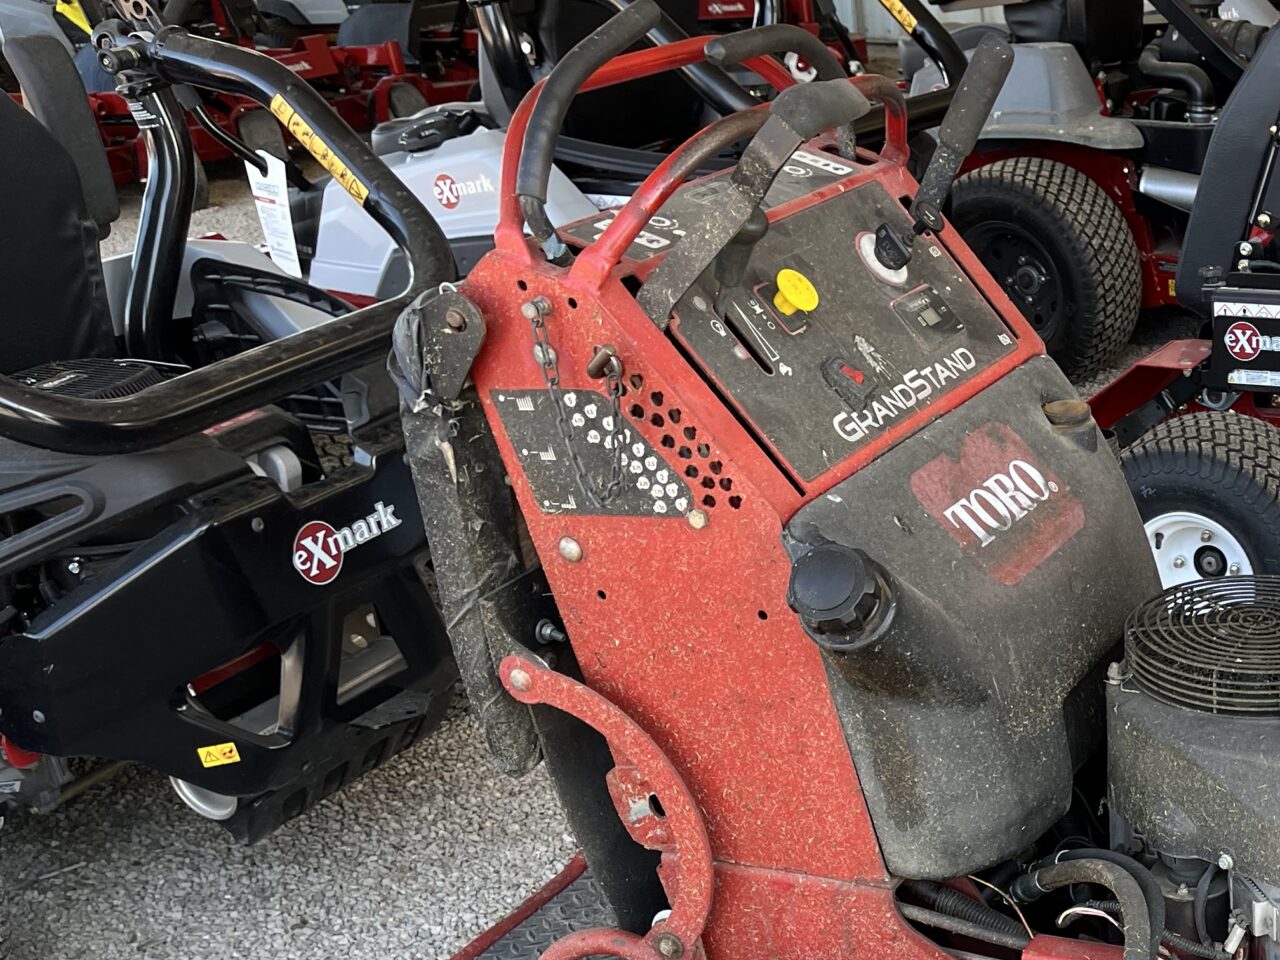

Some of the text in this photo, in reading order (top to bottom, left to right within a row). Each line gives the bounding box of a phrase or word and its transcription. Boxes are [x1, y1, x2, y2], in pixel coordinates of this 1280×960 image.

[433, 173, 495, 205] eXmark
[293, 501, 402, 577] eXmark
[943, 459, 1050, 547] TORO
